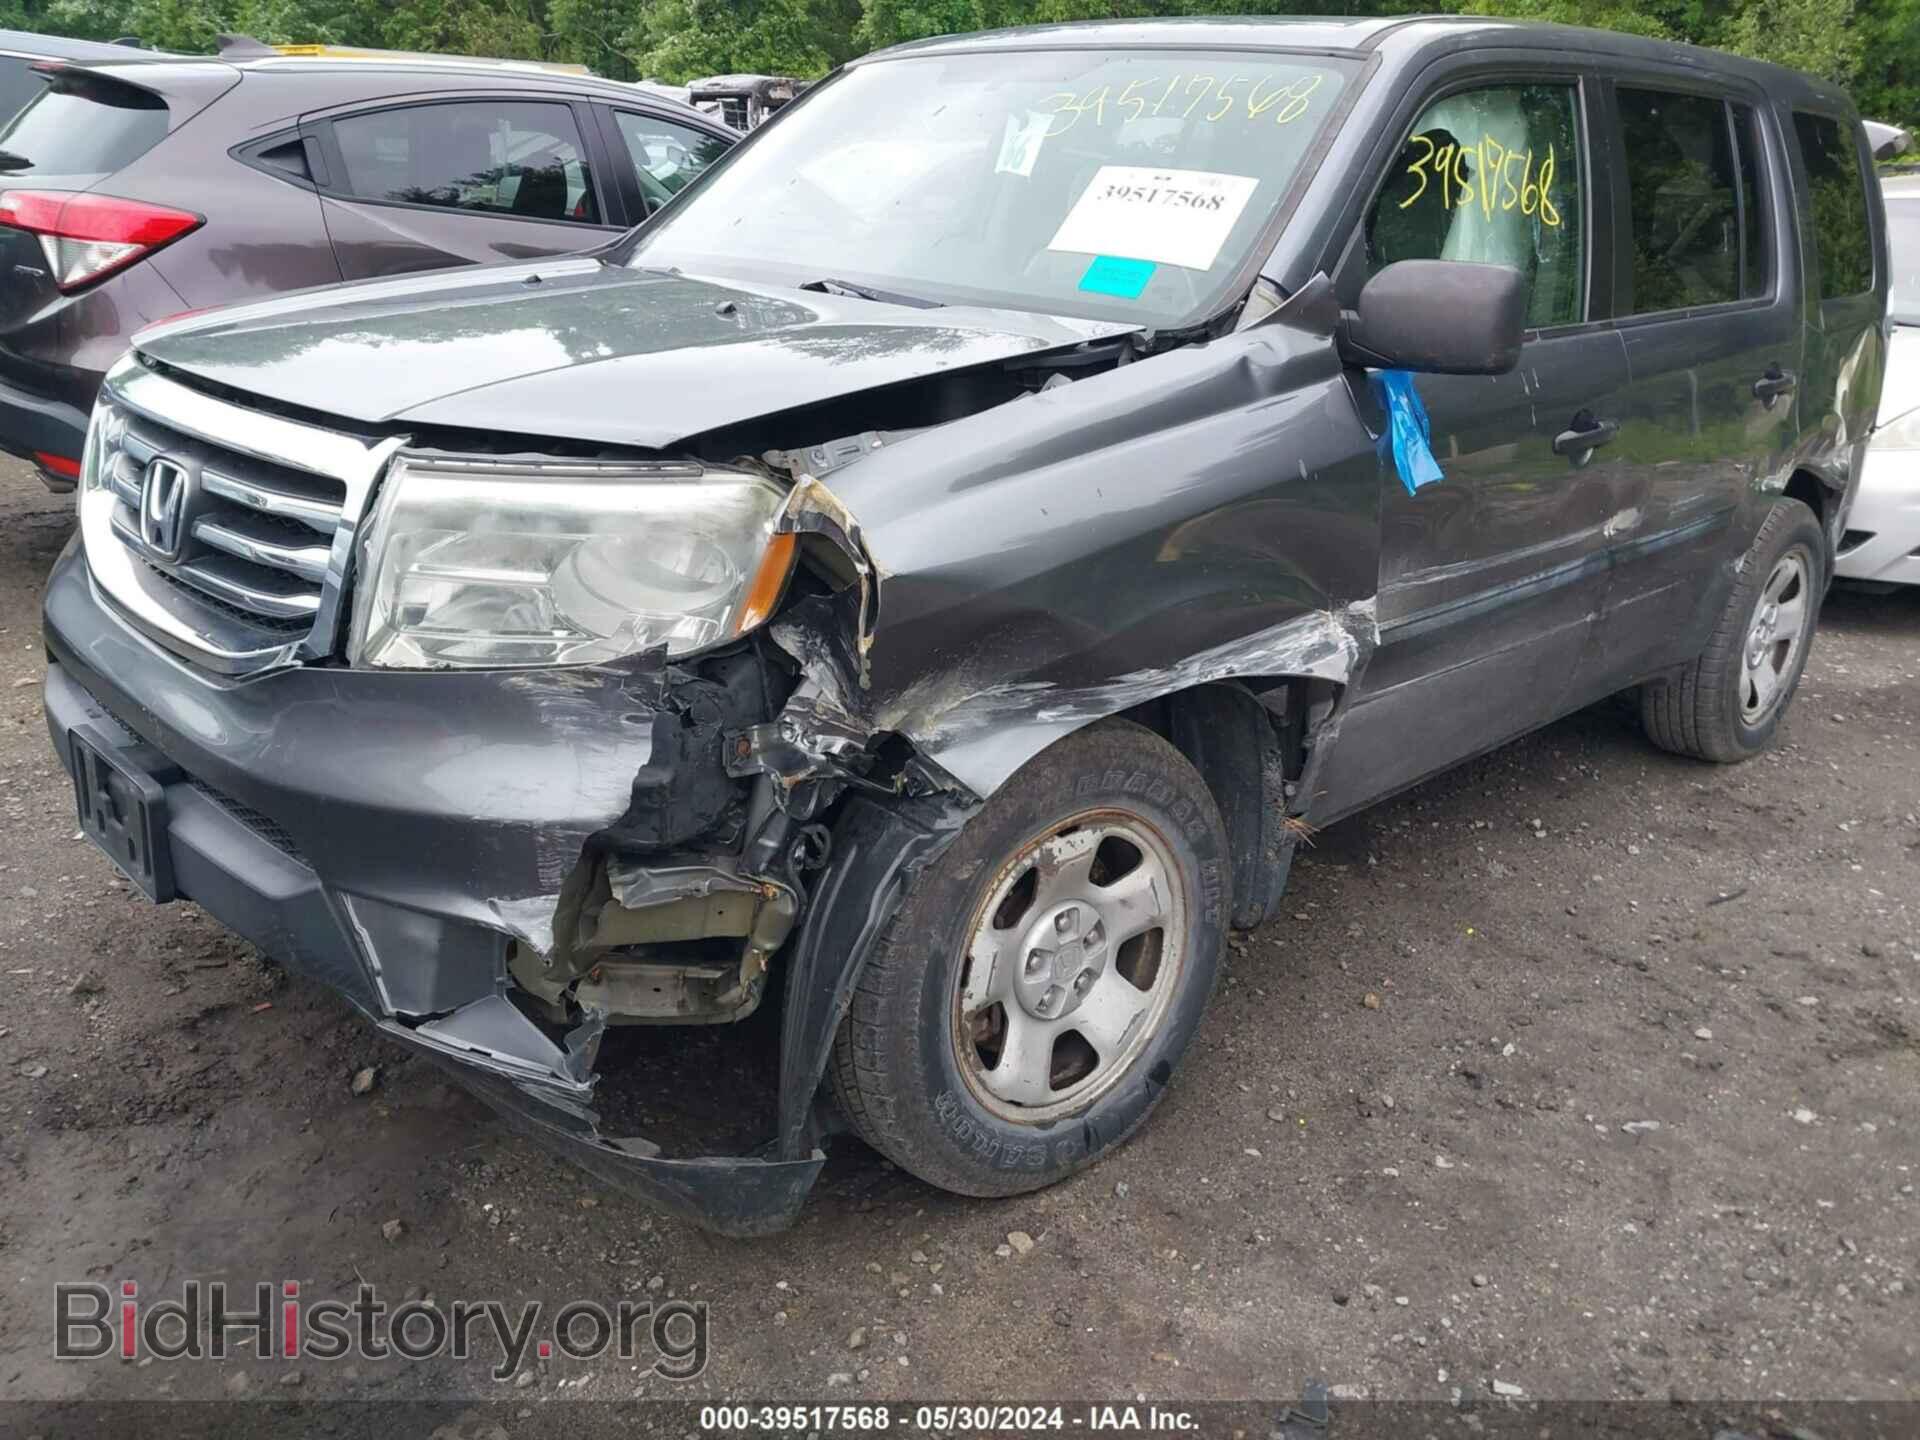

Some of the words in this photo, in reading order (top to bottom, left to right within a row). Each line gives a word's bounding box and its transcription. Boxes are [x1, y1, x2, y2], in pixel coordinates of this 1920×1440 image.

[1038, 74, 1324, 136] 39517568
[1098, 184, 1225, 211] 39517568
[1400, 133, 1560, 225] 39517568
